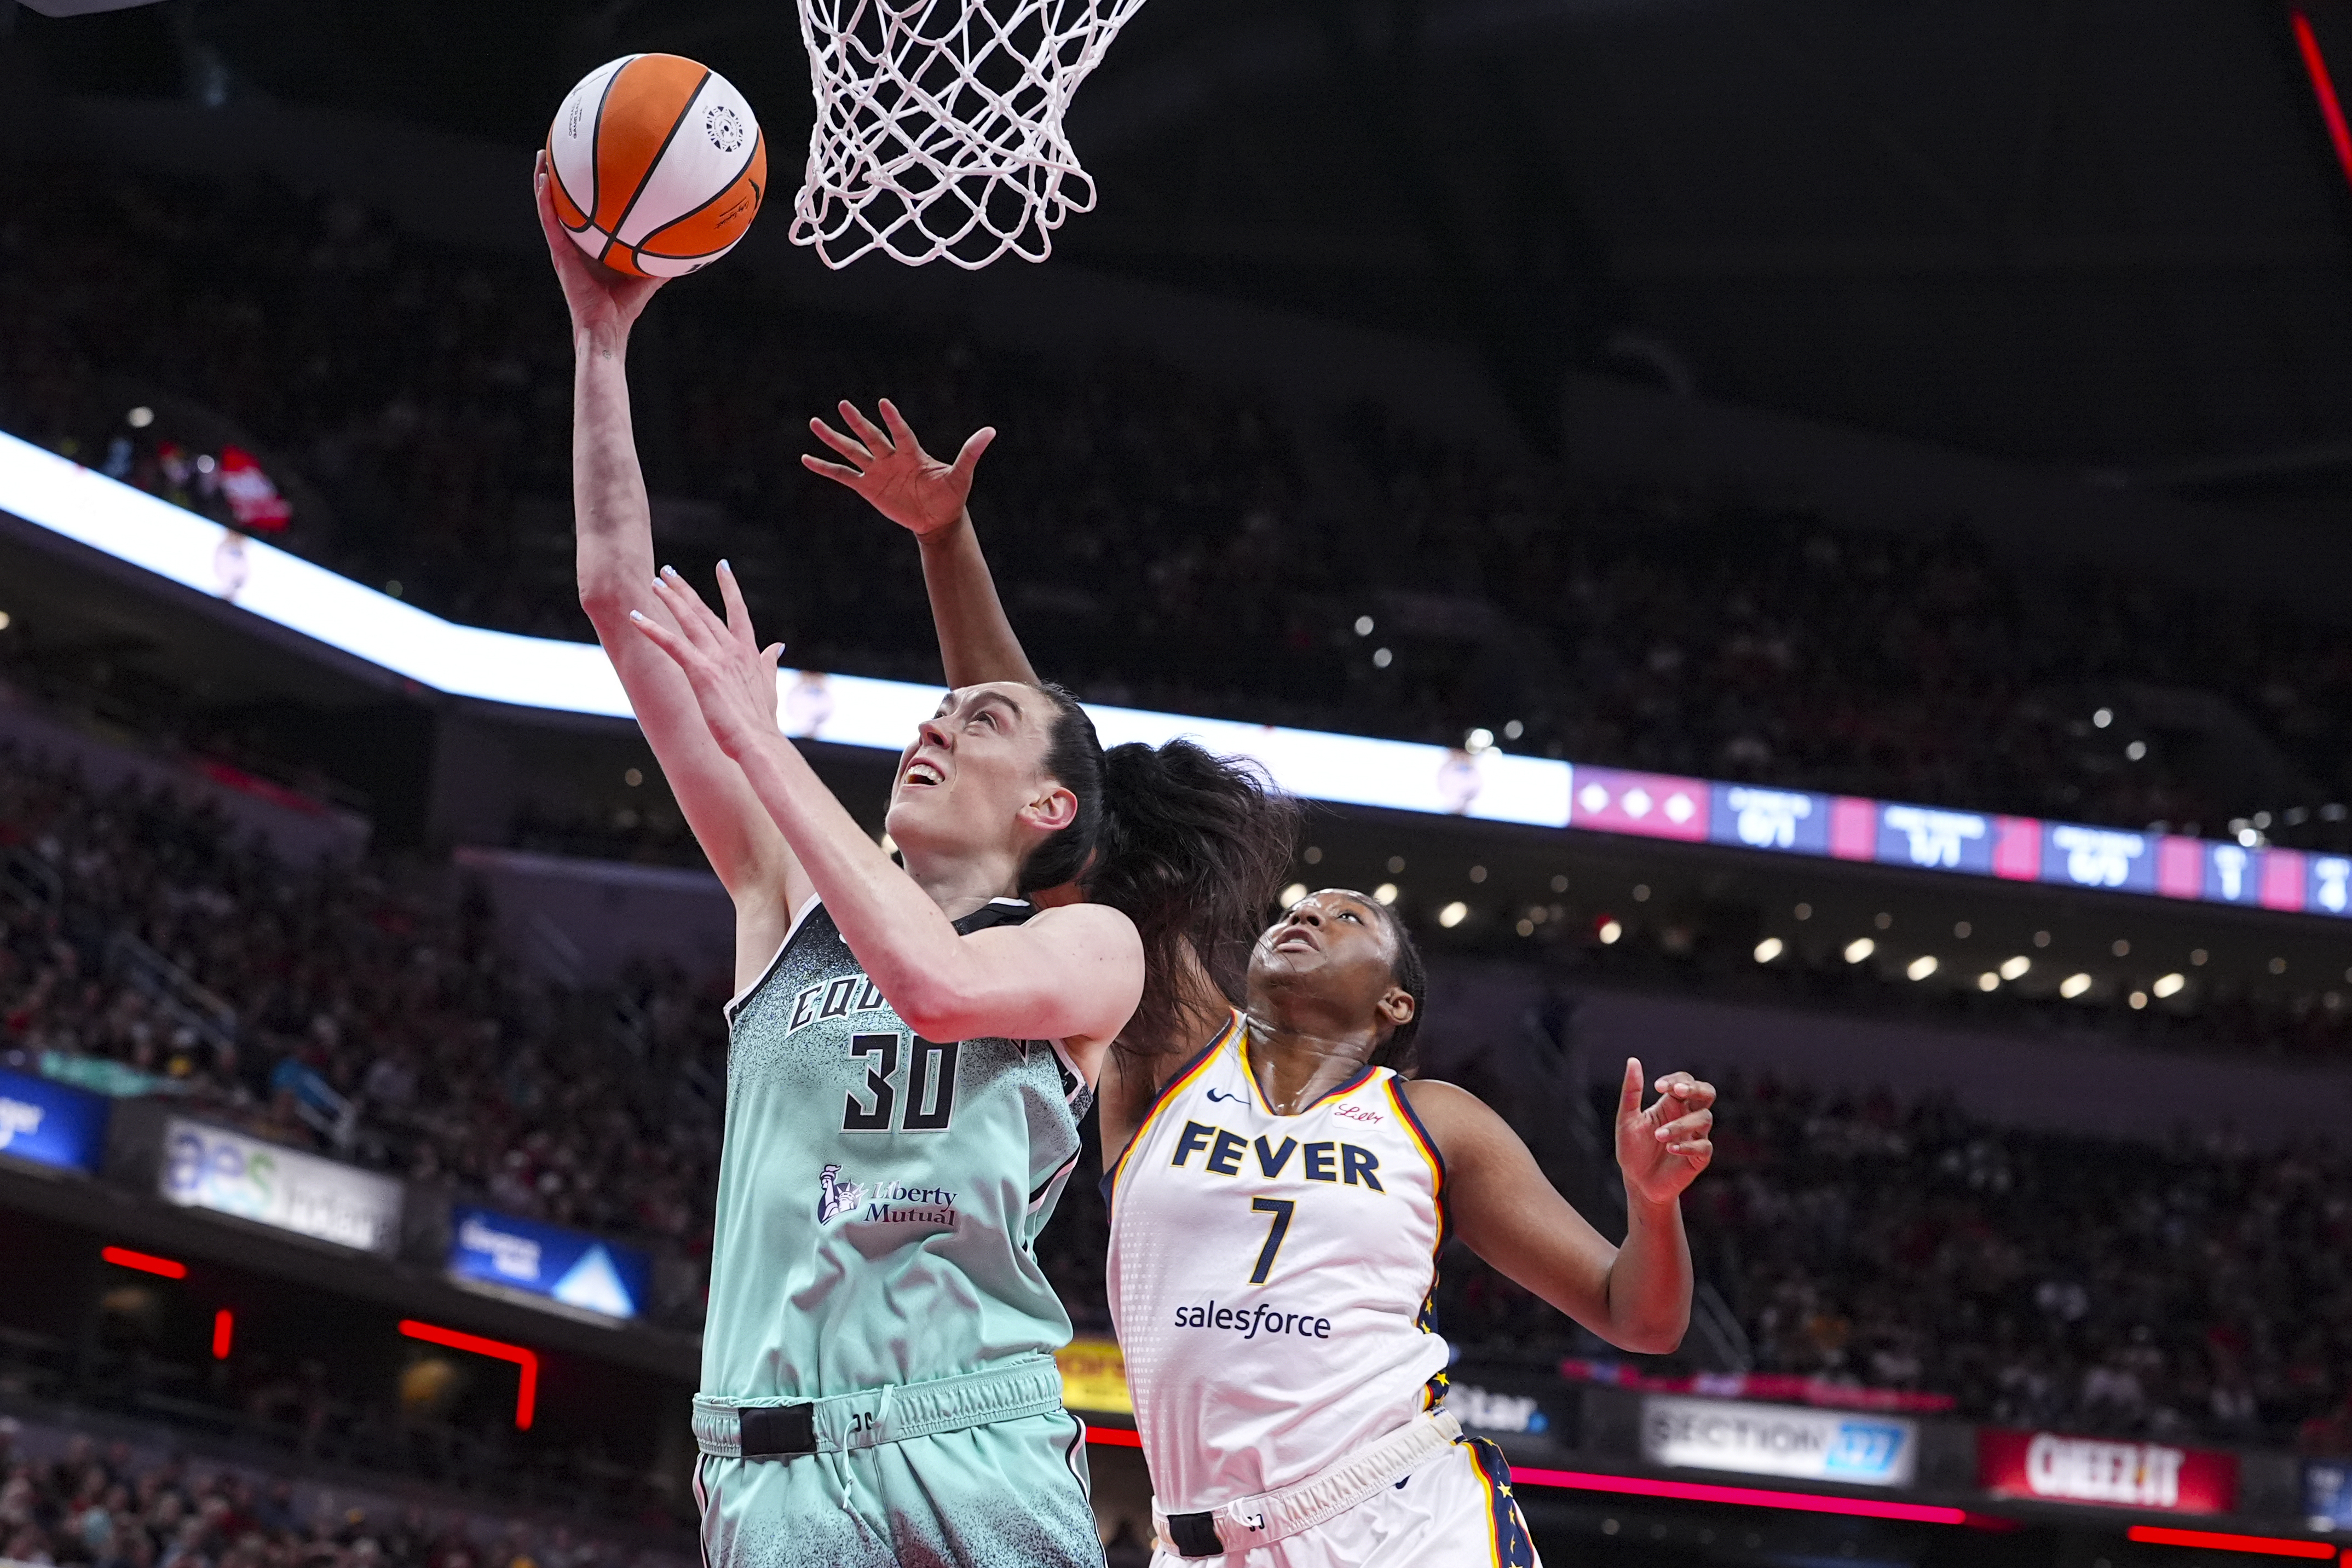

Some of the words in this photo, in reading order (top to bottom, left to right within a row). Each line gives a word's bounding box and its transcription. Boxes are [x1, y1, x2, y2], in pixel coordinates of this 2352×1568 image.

[839, 1031, 962, 1133] 30
[1334, 1103, 1384, 1124] Lilly
[1171, 1119, 1387, 1195] FEVER
[863, 1203, 955, 1226] Mutual
[869, 1179, 958, 1213] Liberty
[1246, 1195, 1296, 1287] 7
[1174, 1300, 1331, 1339] salesforce
[1651, 1411, 1826, 1455] SECTION
